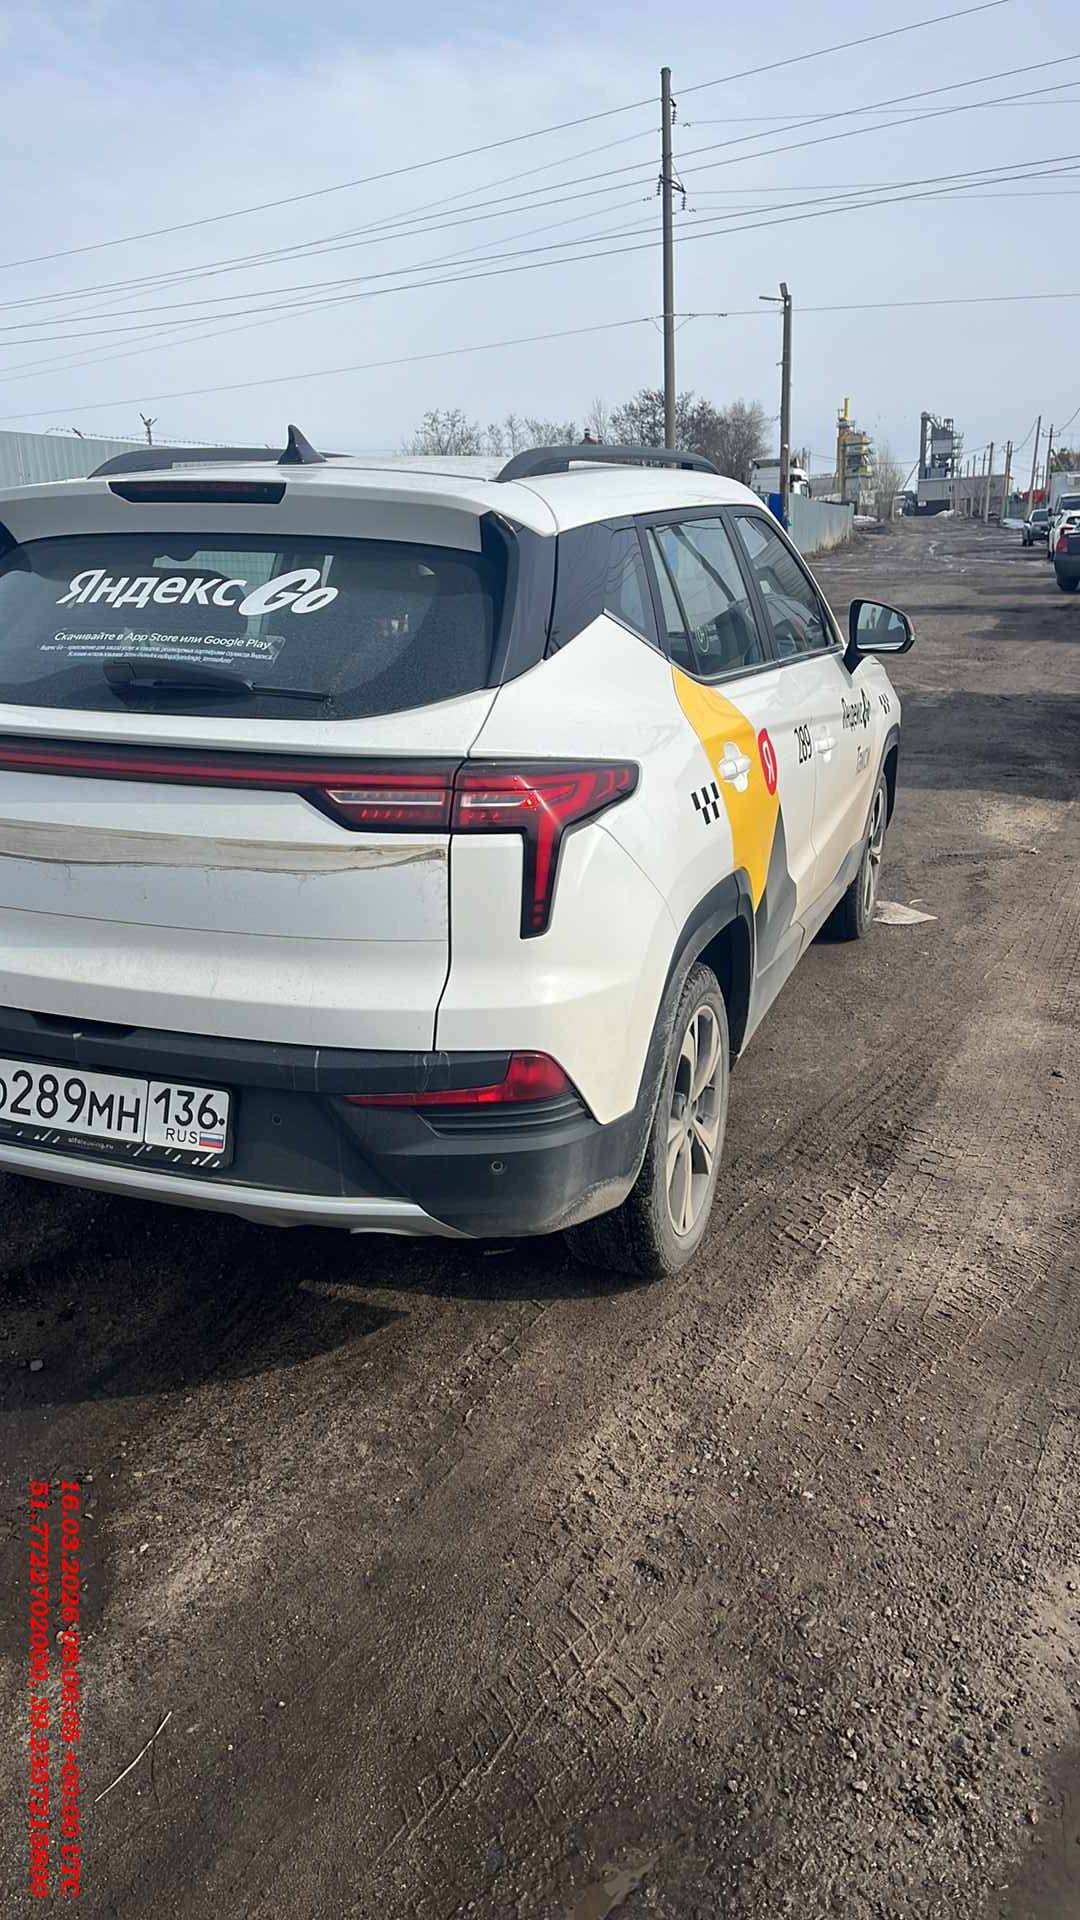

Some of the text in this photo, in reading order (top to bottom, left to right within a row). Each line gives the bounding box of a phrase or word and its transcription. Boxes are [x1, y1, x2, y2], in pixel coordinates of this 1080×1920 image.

[56, 568, 339, 616] Яндекс Go
[54, 632, 116, 641] Скачивайте
[124, 632, 148, 642] App
[149, 633, 179, 642] Store
[180, 634, 202, 643] или
[203, 635, 245, 647] Google
[246, 639, 272, 650] Play
[794, 723, 813, 764] 289
[154, 1087, 219, 1130] 136
[165, 1127, 198, 1144] RUS
